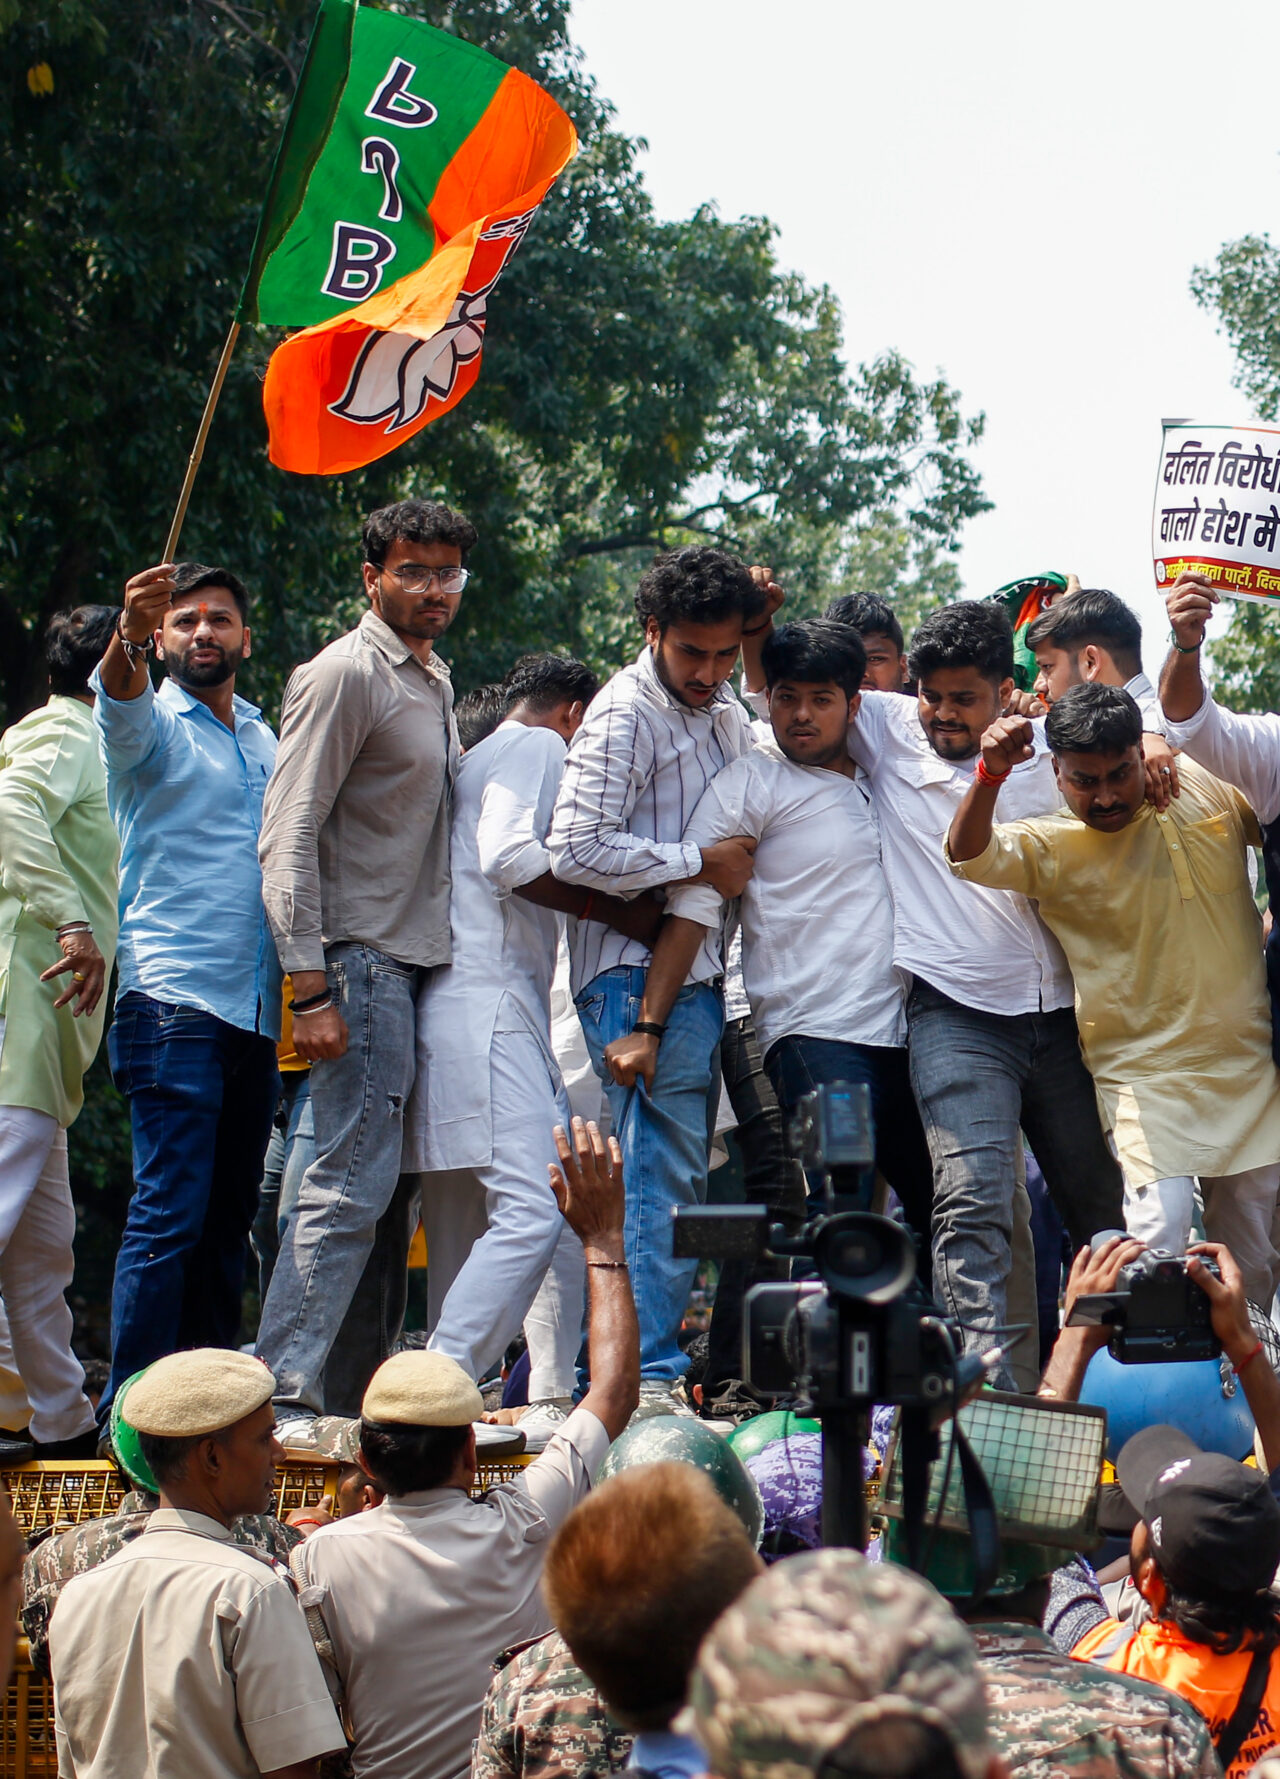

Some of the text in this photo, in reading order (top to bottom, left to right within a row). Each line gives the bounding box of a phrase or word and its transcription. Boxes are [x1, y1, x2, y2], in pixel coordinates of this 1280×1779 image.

[1163, 440, 1215, 486] दलित
[1160, 496, 1201, 542] वालो
[1200, 497, 1251, 547] होश
